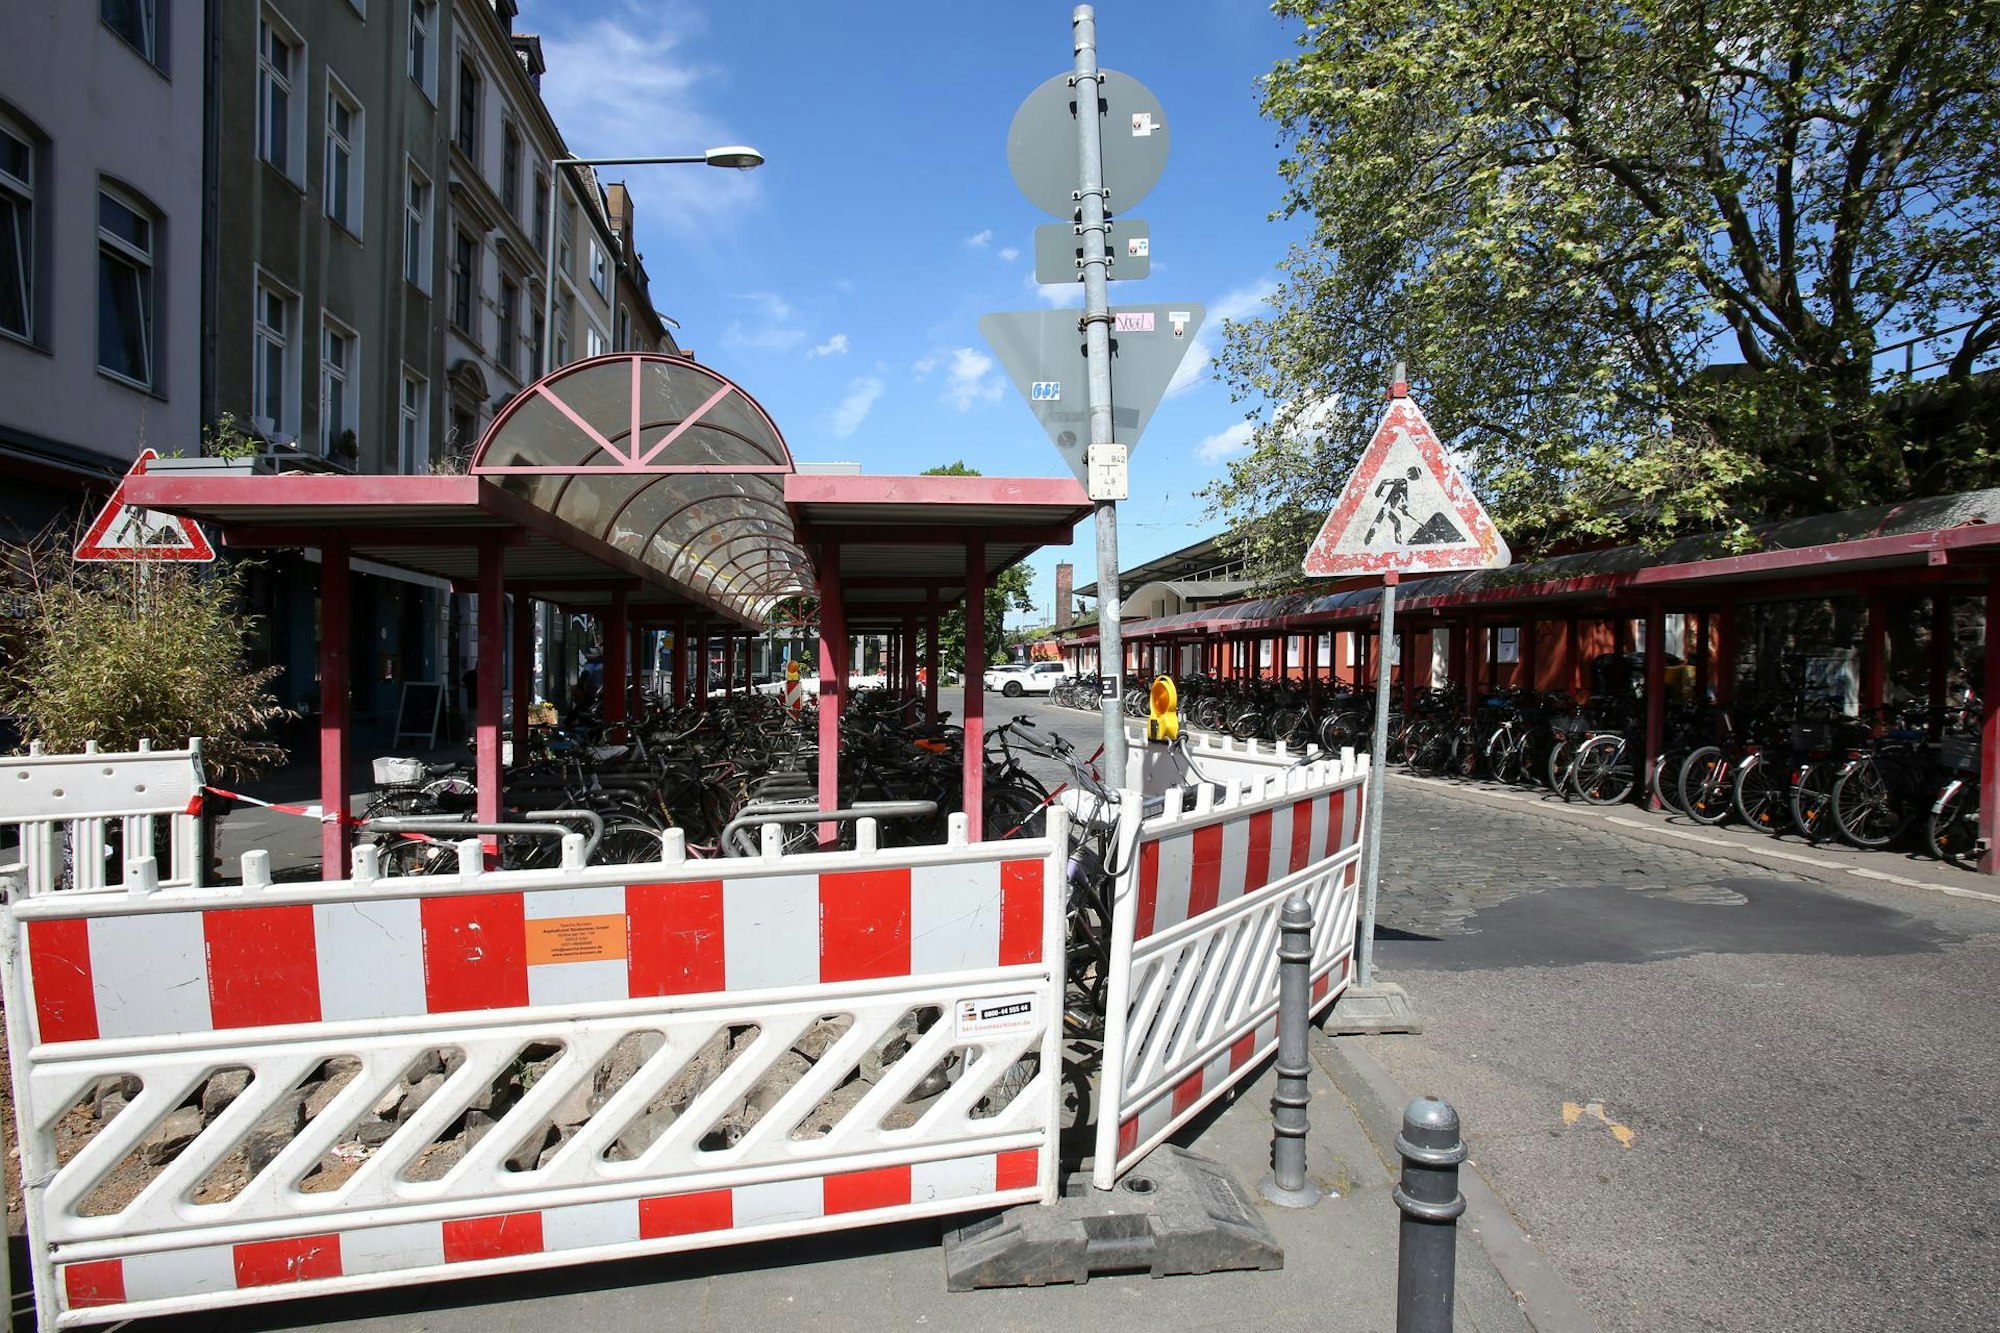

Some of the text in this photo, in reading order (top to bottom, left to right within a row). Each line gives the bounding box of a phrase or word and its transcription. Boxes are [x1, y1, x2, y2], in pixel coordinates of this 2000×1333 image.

[1090, 455, 1126, 464] K 842
[1009, 1006, 1020, 1014] 555
